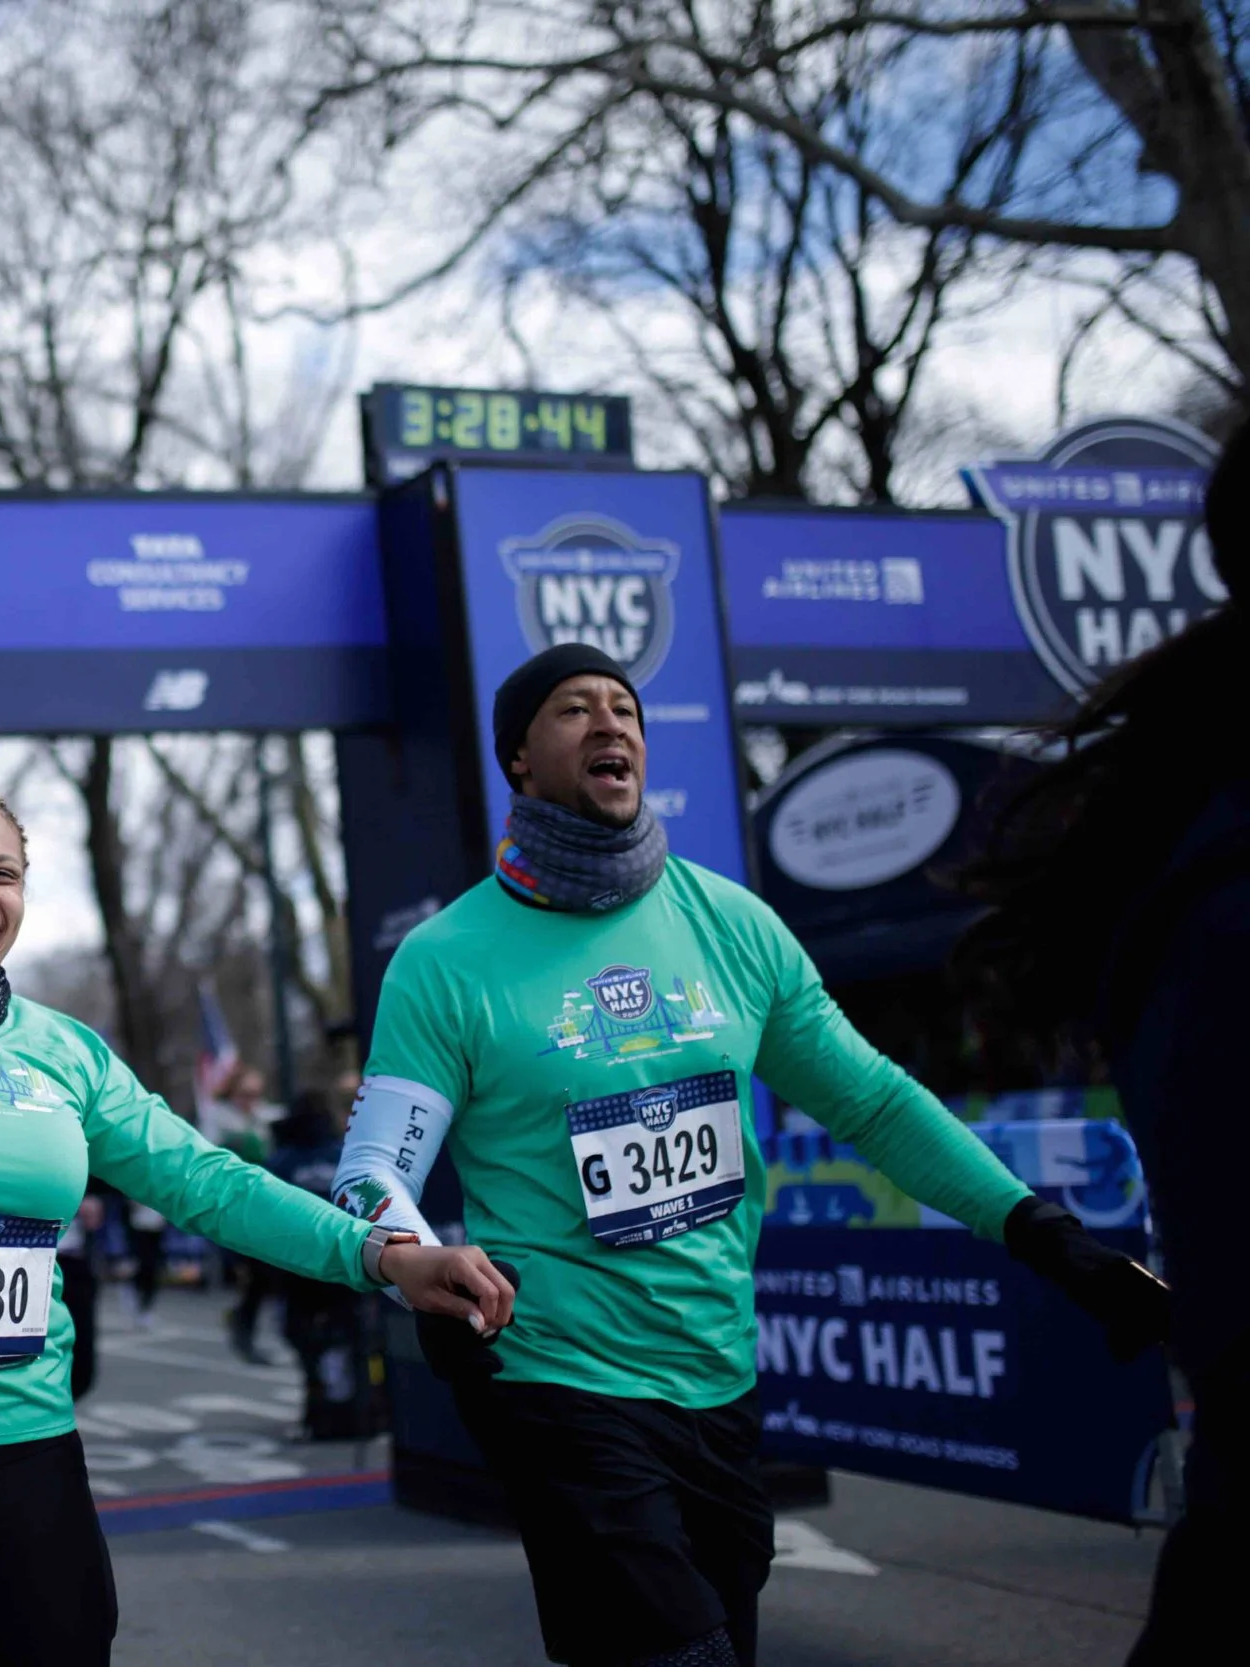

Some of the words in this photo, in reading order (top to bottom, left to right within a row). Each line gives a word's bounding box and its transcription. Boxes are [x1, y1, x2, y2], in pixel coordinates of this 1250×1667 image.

[1001, 475, 1110, 501] UNITED
[782, 559, 879, 580] UNITED
[540, 573, 648, 627] NYC
[763, 579, 881, 602] AIRLINES
[1076, 606, 1220, 667] HA
[602, 980, 644, 1002] NYC
[610, 996, 644, 1012] HALF
[641, 1101, 672, 1118] NYC
[646, 1113, 671, 1127] HALF
[623, 1124, 717, 1195] 3429
[582, 1154, 612, 1196] G
[650, 1200, 685, 1220] WAVE
[686, 1195, 694, 1209] 1
[868, 1274, 1000, 1307] AIRLINES
[756, 1312, 853, 1383] NYC
[860, 1319, 1007, 1399] HALF
